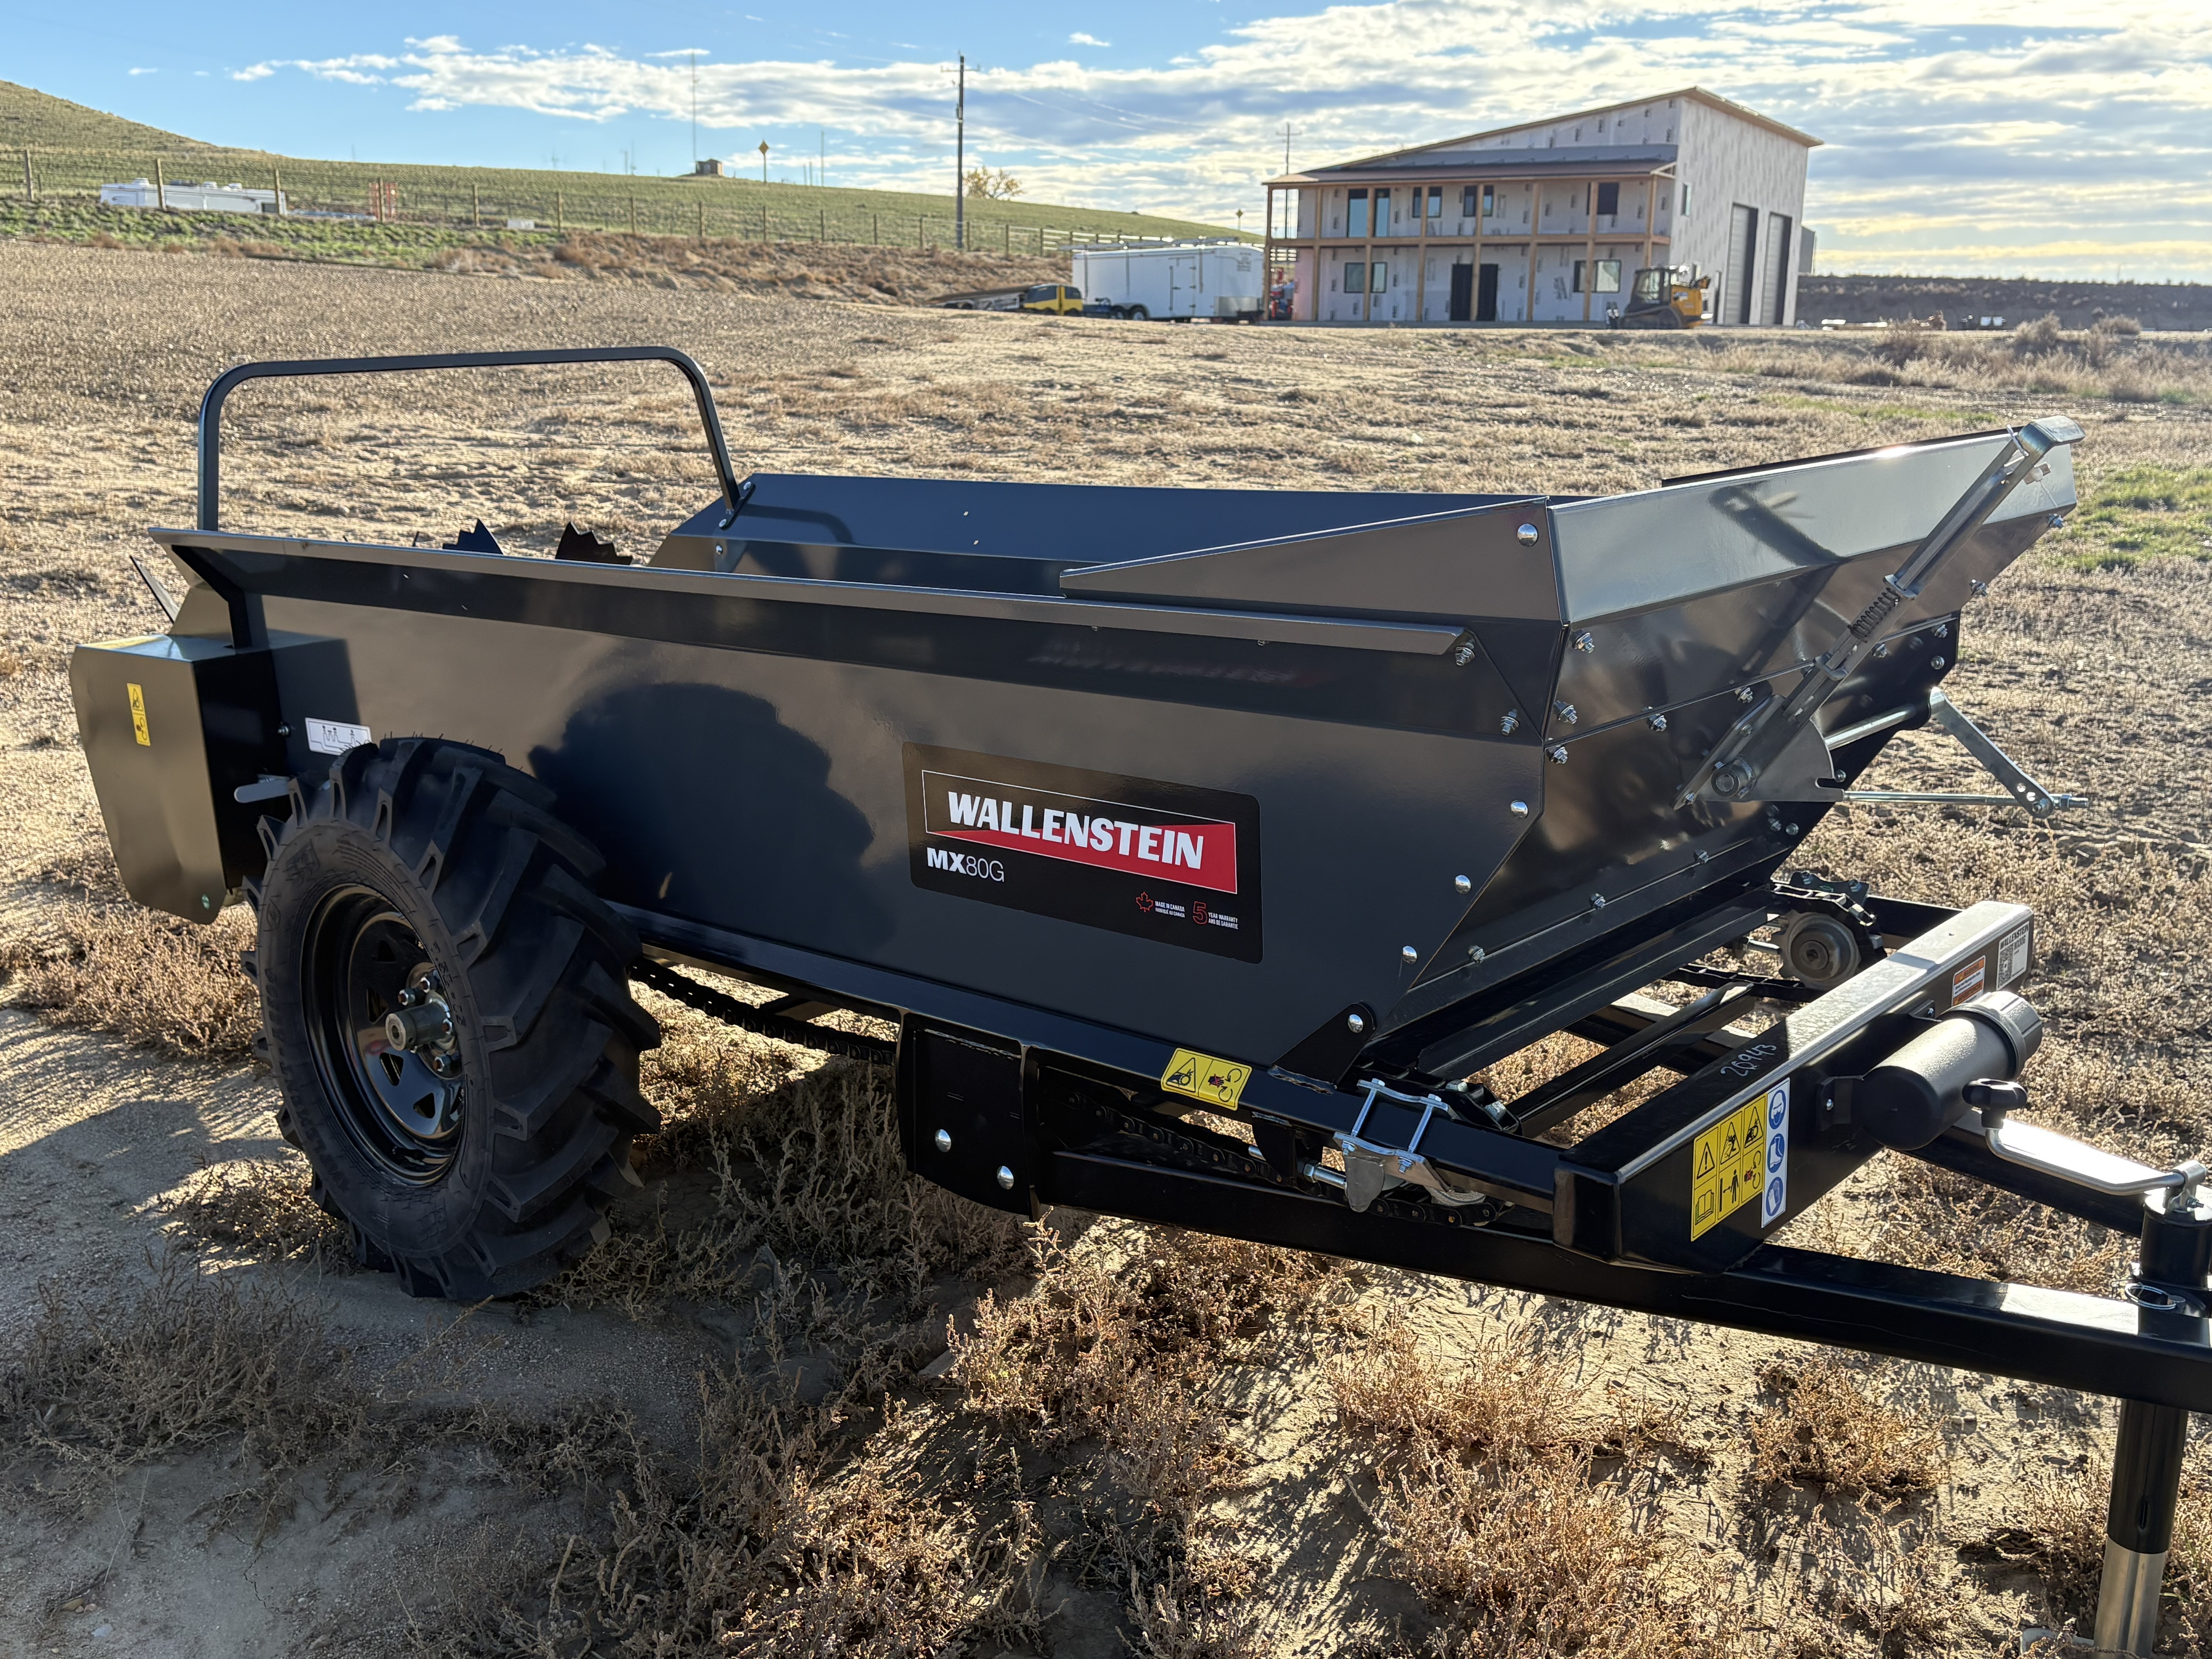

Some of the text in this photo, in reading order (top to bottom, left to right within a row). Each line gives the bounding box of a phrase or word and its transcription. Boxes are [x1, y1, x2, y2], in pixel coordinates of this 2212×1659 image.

[948, 791, 1204, 869] WALLENSTEIN
[927, 847, 1005, 883] MX80G
[1170, 904, 1185, 912] CANADA
[1193, 901, 1207, 925] 5
[1218, 914, 1238, 924] WARRANTY
